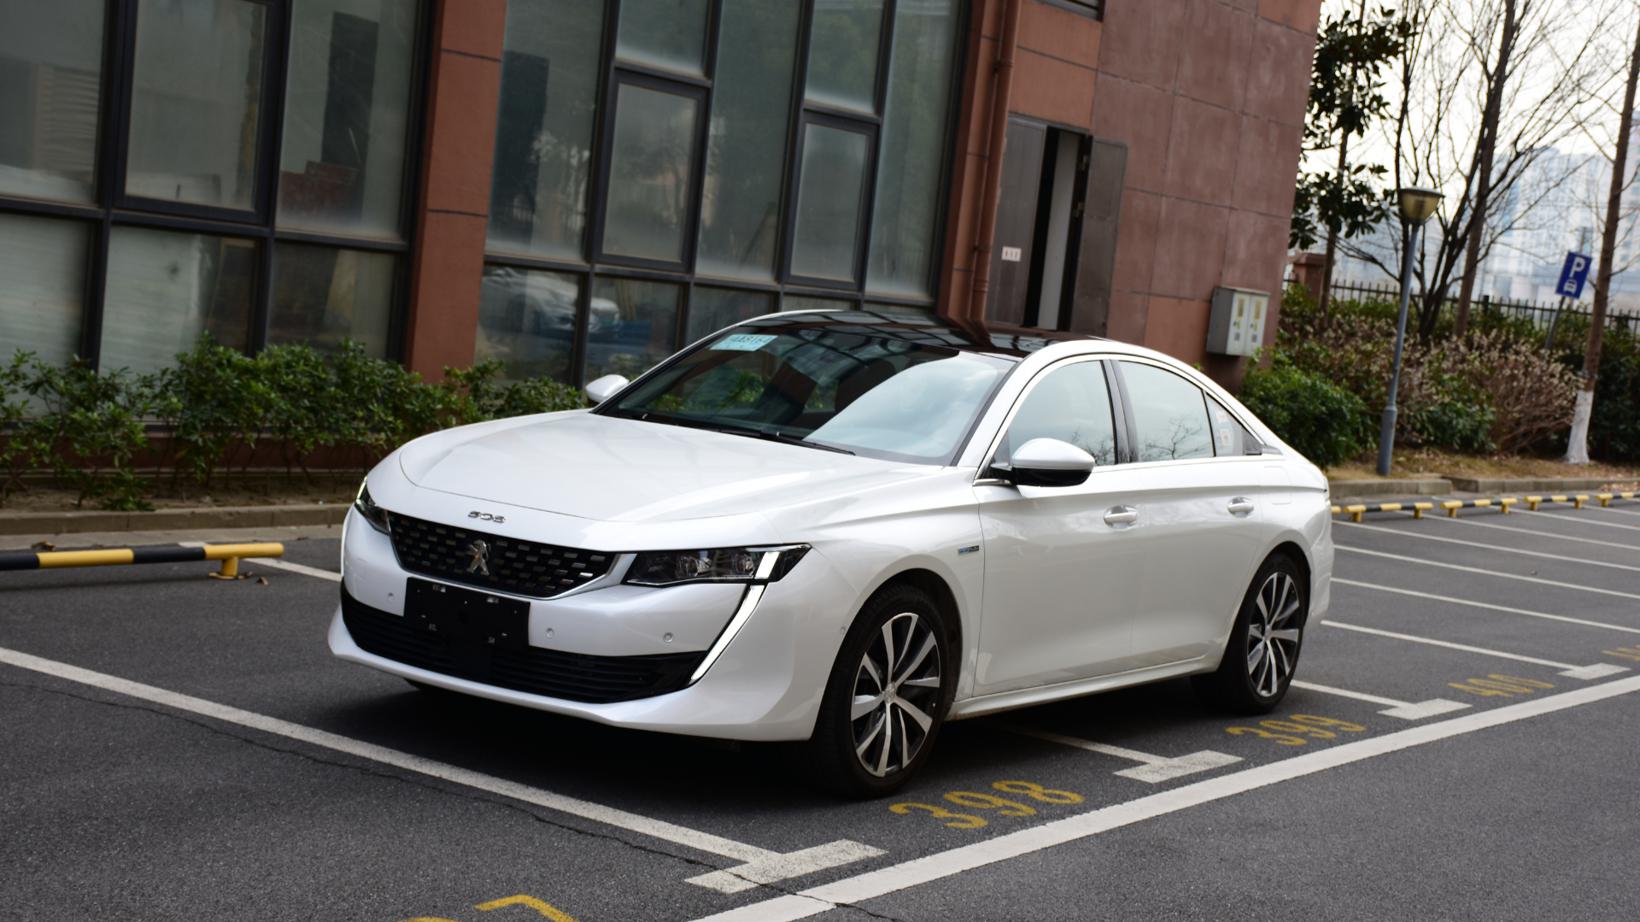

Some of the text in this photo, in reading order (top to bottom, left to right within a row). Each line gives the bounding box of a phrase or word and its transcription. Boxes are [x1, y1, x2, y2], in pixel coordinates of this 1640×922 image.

[1569, 256, 1586, 278] P
[1225, 714, 1366, 746] 399
[889, 780, 1085, 829] 398
